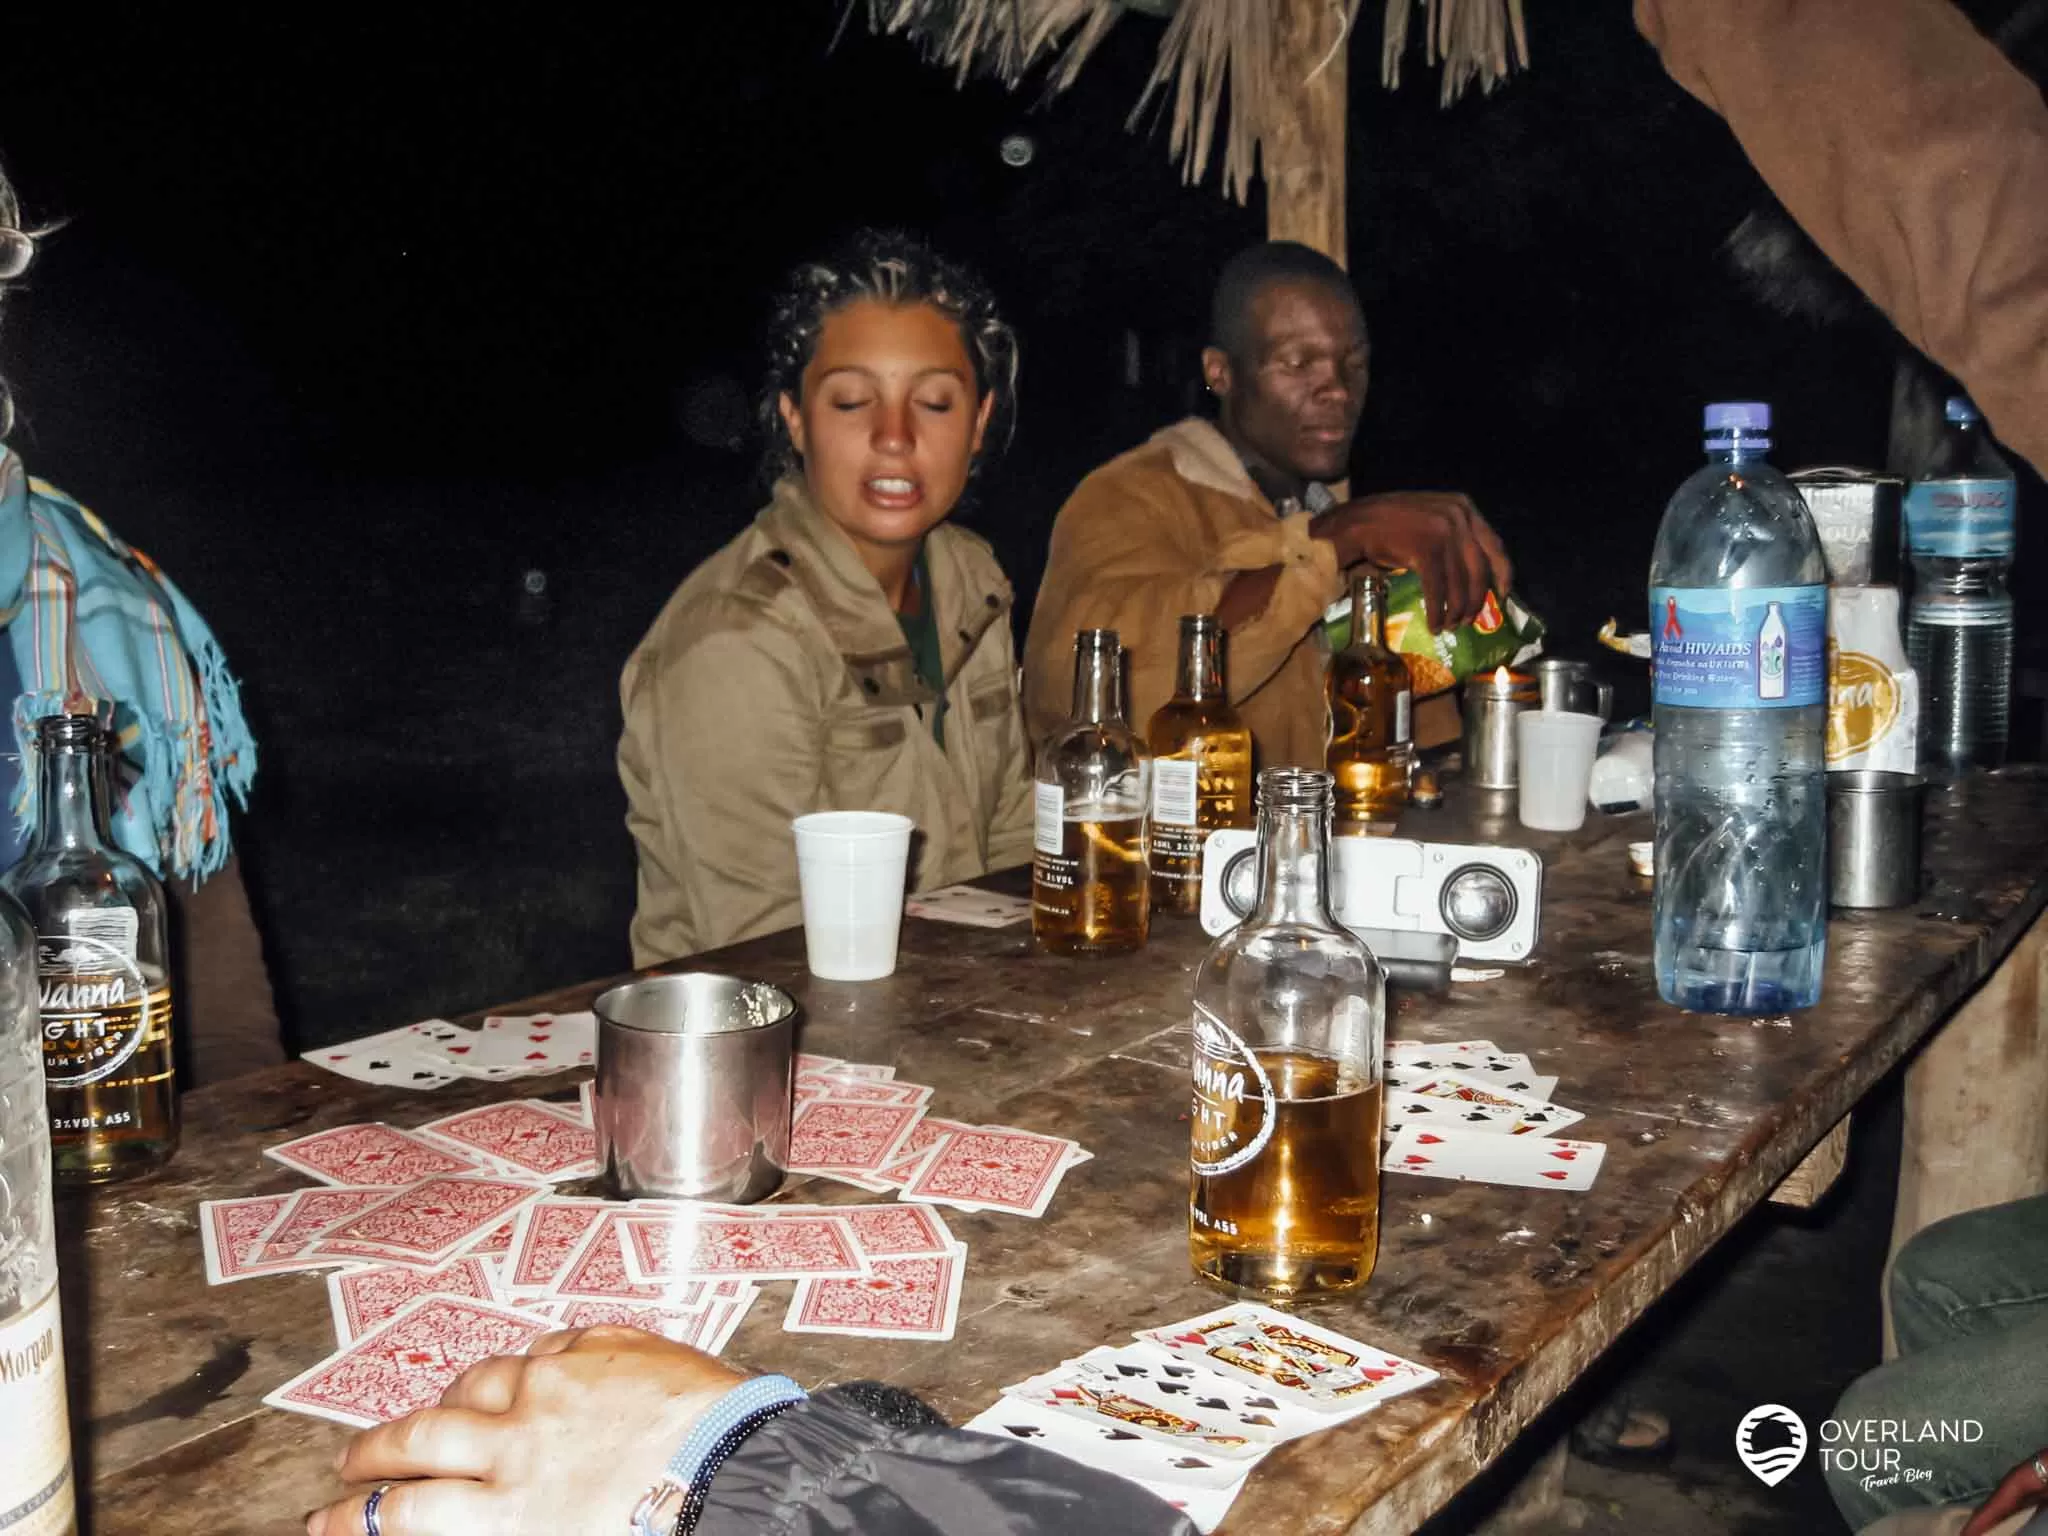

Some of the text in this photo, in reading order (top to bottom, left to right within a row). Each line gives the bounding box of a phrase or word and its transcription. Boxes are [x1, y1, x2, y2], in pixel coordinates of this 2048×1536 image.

[1685, 641, 1752, 656] HIV/AIDS
[39, 977, 125, 1009] vanna
[44, 1017, 111, 1039] GHT
[1191, 1097, 1227, 1131] GHT
[0, 1327, 54, 1385] Morgan
